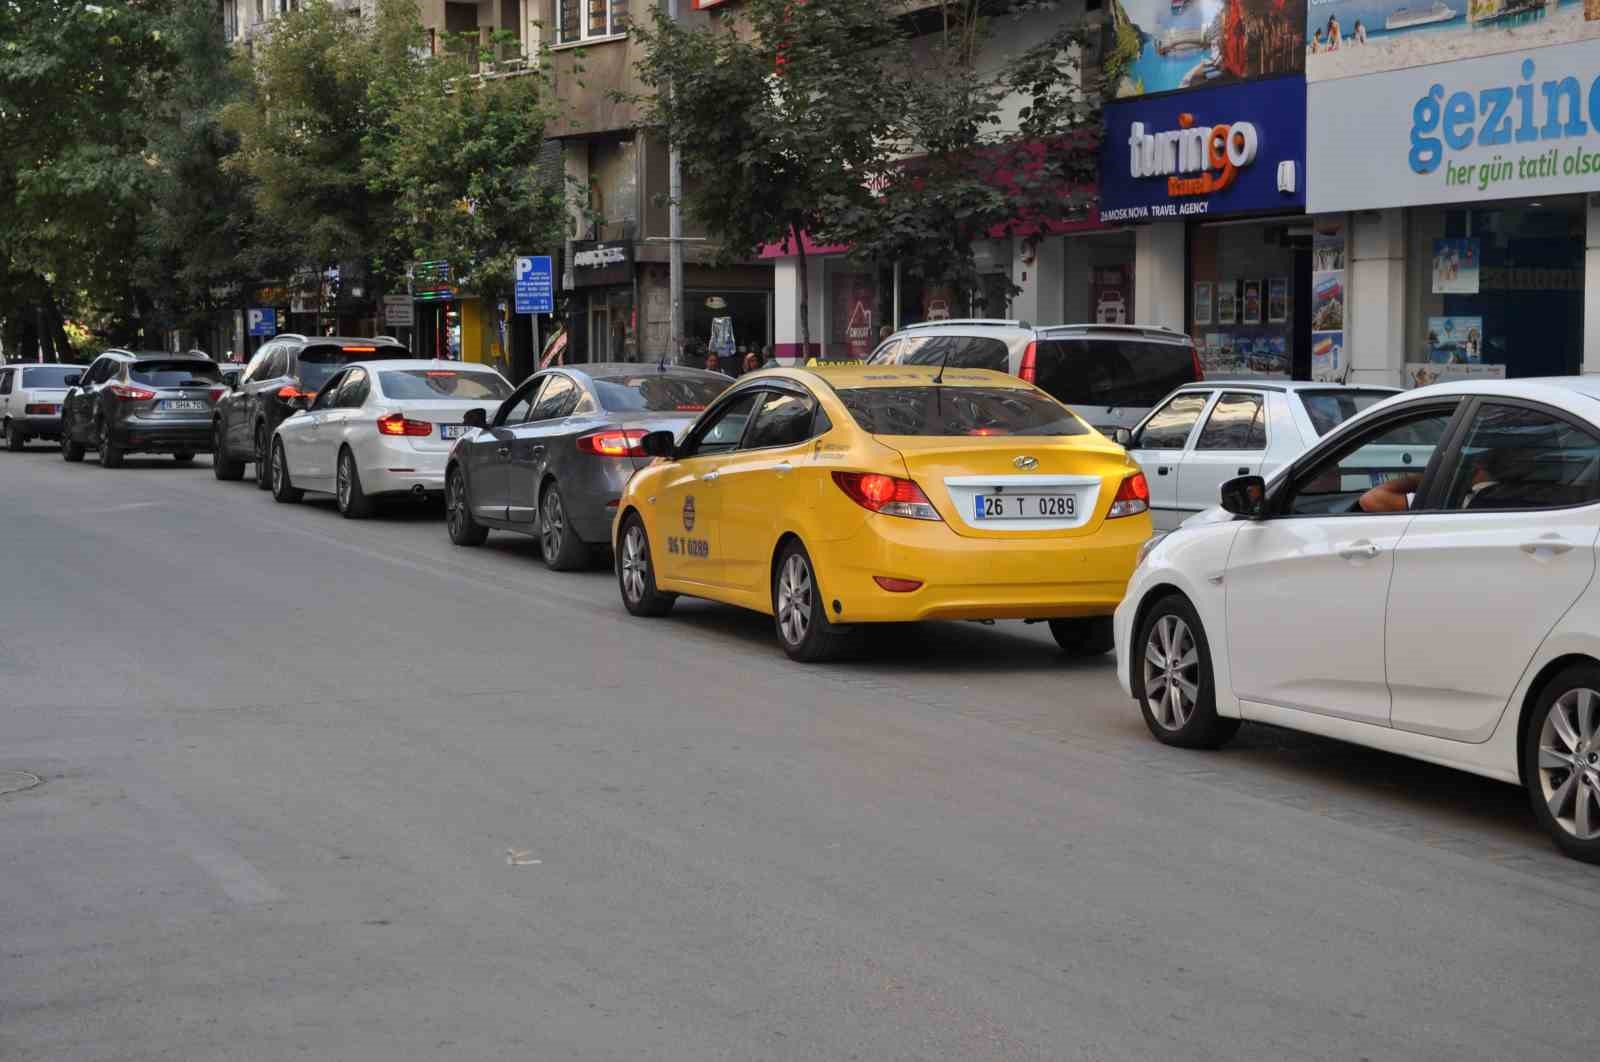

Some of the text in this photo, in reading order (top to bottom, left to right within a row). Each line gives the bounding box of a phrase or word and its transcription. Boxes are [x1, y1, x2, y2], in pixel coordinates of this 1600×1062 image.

[1128, 112, 1258, 187] turingo
[1446, 160, 1477, 186] her
[1478, 155, 1513, 191] gün
[1519, 149, 1558, 180] tatil
[1152, 204, 1177, 217] TRAVEL
[1180, 201, 1209, 215] AGENCY
[516, 258, 532, 280] P
[248, 310, 263, 330] P
[985, 497, 1074, 516] 26 T 0289
